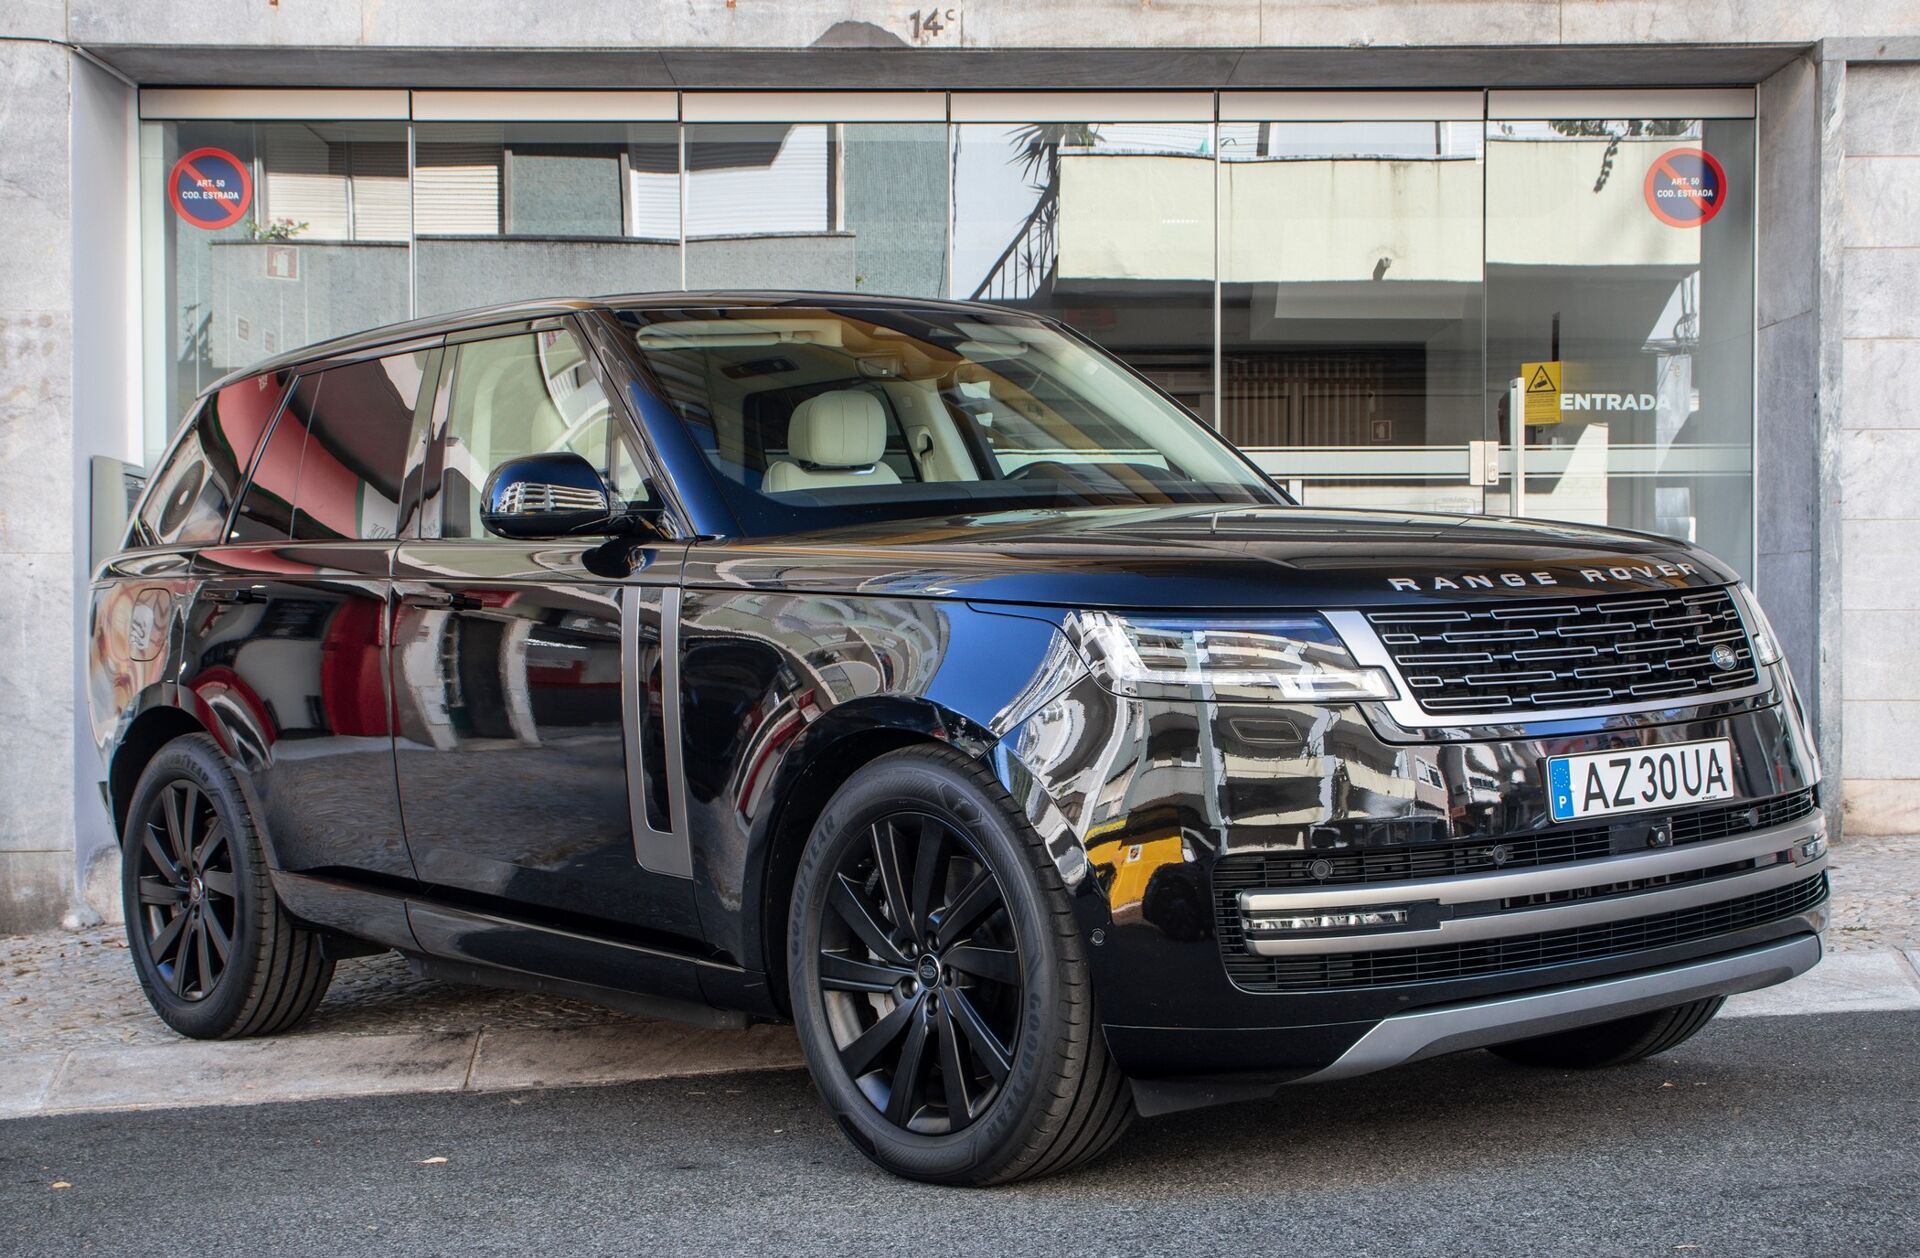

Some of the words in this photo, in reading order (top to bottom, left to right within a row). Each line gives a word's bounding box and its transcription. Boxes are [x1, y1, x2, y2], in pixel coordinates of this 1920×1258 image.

[196, 179, 215, 188] ART.
[216, 179, 226, 188] 50
[1671, 177, 1689, 186] ART.
[1690, 177, 1700, 186] 50
[182, 191, 202, 200] COD.
[203, 191, 240, 200] ESTRADA
[1657, 189, 1676, 198] COD.
[1677, 189, 1714, 198] ESTRADA
[1559, 393, 1671, 411] ENTRADA
[1387, 571, 1558, 592] RANGE
[1580, 562, 1699, 583] ROVER
[1558, 795, 1567, 809] P
[790, 814, 836, 957] GOODYEAR
